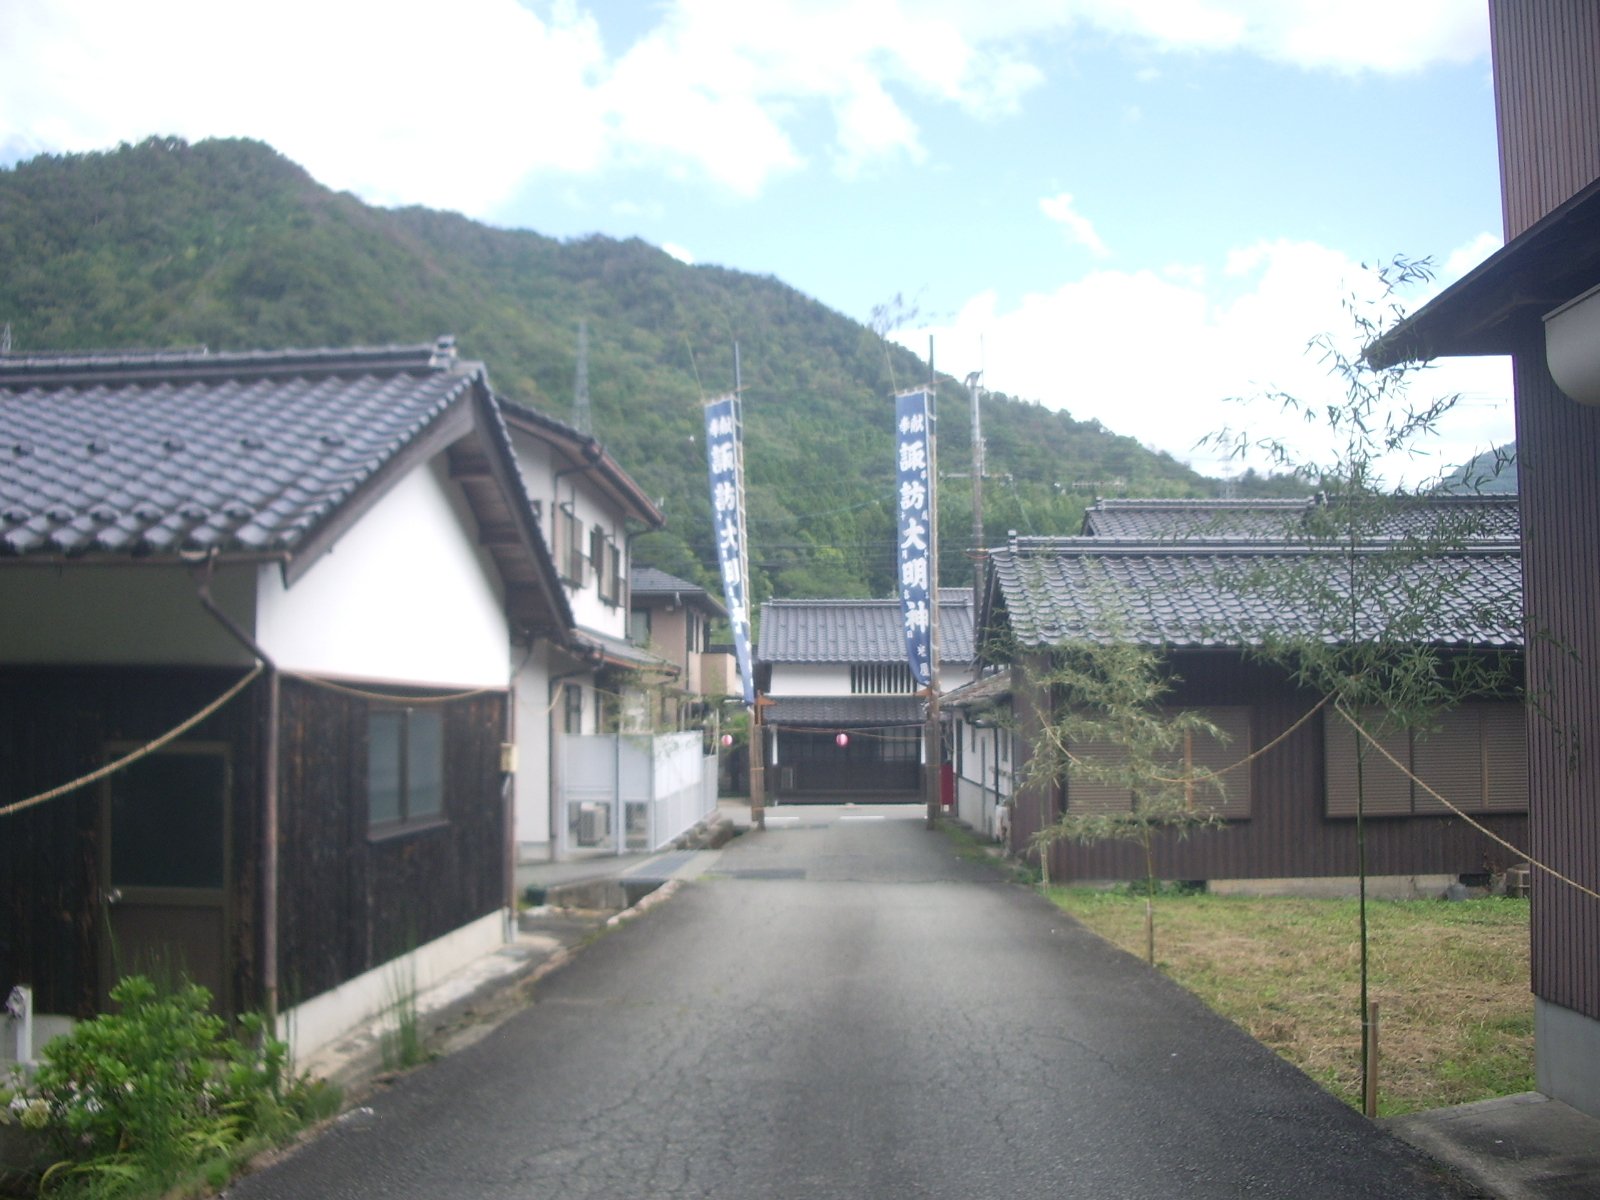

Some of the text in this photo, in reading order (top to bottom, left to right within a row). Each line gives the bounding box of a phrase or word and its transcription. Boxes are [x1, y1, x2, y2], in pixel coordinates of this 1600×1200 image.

[899, 440, 929, 633] 諏訪大明神
